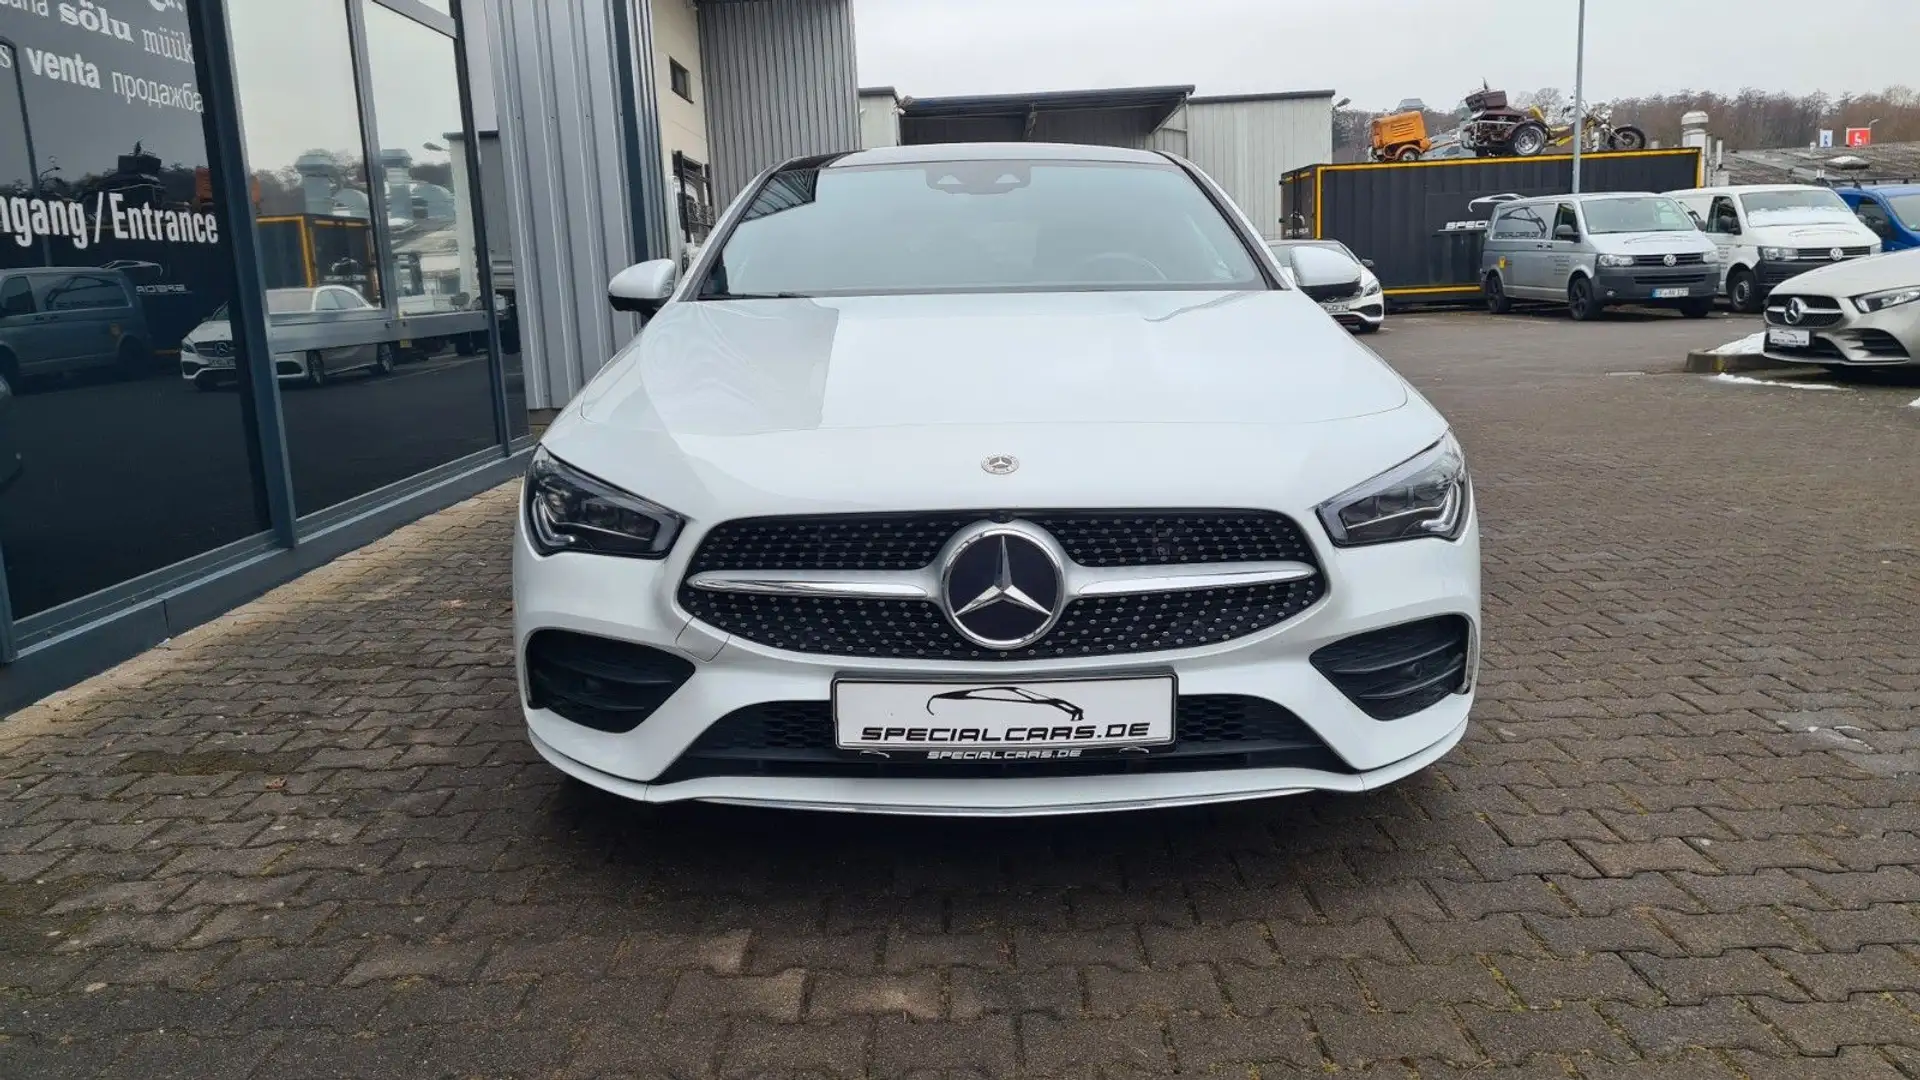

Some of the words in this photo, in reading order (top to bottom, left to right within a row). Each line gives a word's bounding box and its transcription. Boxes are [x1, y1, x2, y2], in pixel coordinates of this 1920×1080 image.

[58, 0, 134, 42] sölu
[141, 26, 195, 64] müük
[26, 47, 101, 89] venta
[112, 71, 205, 114] продажба
[108, 192, 219, 244] Entrance
[861, 722, 1151, 742] SPECIALCARS.DE
[927, 749, 1083, 760] SPECIALCARS.DE
